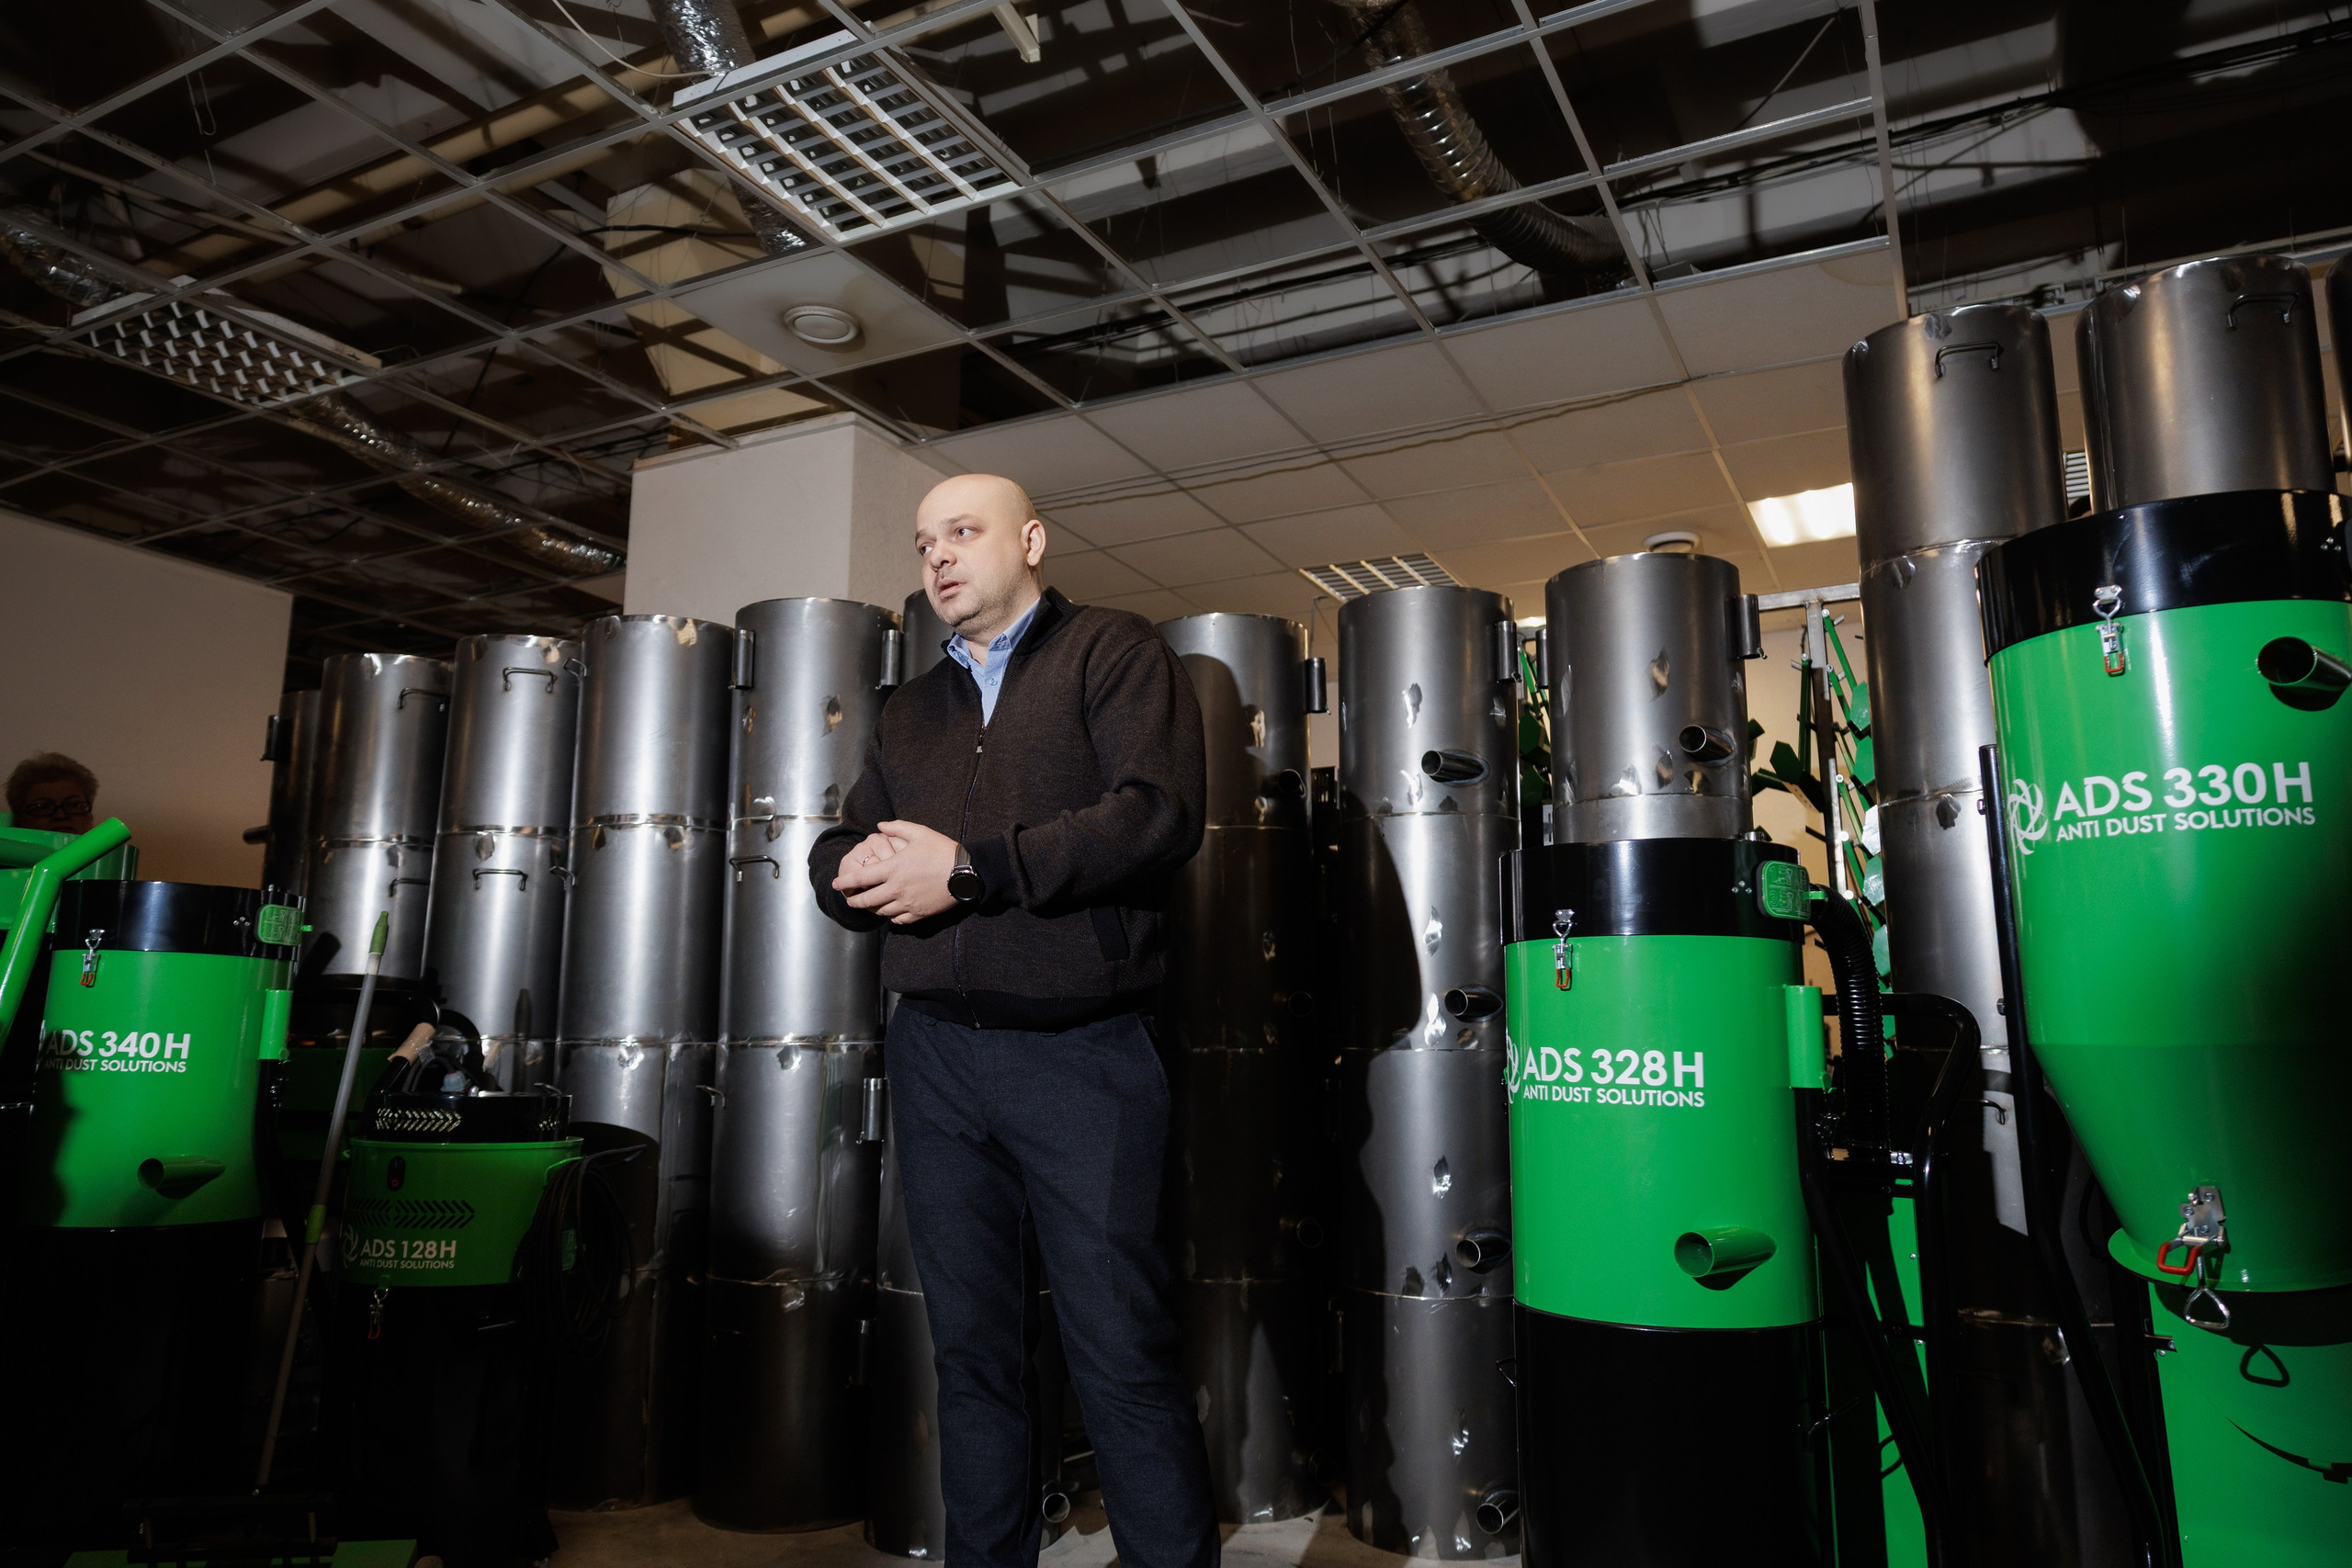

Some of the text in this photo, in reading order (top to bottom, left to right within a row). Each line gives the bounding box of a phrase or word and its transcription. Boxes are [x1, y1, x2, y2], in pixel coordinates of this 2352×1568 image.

[2053, 771, 2152, 820] ADS
[2056, 807, 2315, 841] ANTI DUST SOLUTIONS
[47, 1030, 94, 1056] ADS
[45, 1058, 187, 1073] ANTI DUST SOLUTIONS
[1522, 1046, 1583, 1083] ADS
[1523, 1084, 1705, 1107] ANTI DUST SOLUTIONS
[360, 1239, 395, 1258] ADS
[377, 1260, 398, 1269] DUST
[401, 1260, 454, 1269] SOLUTIONS
